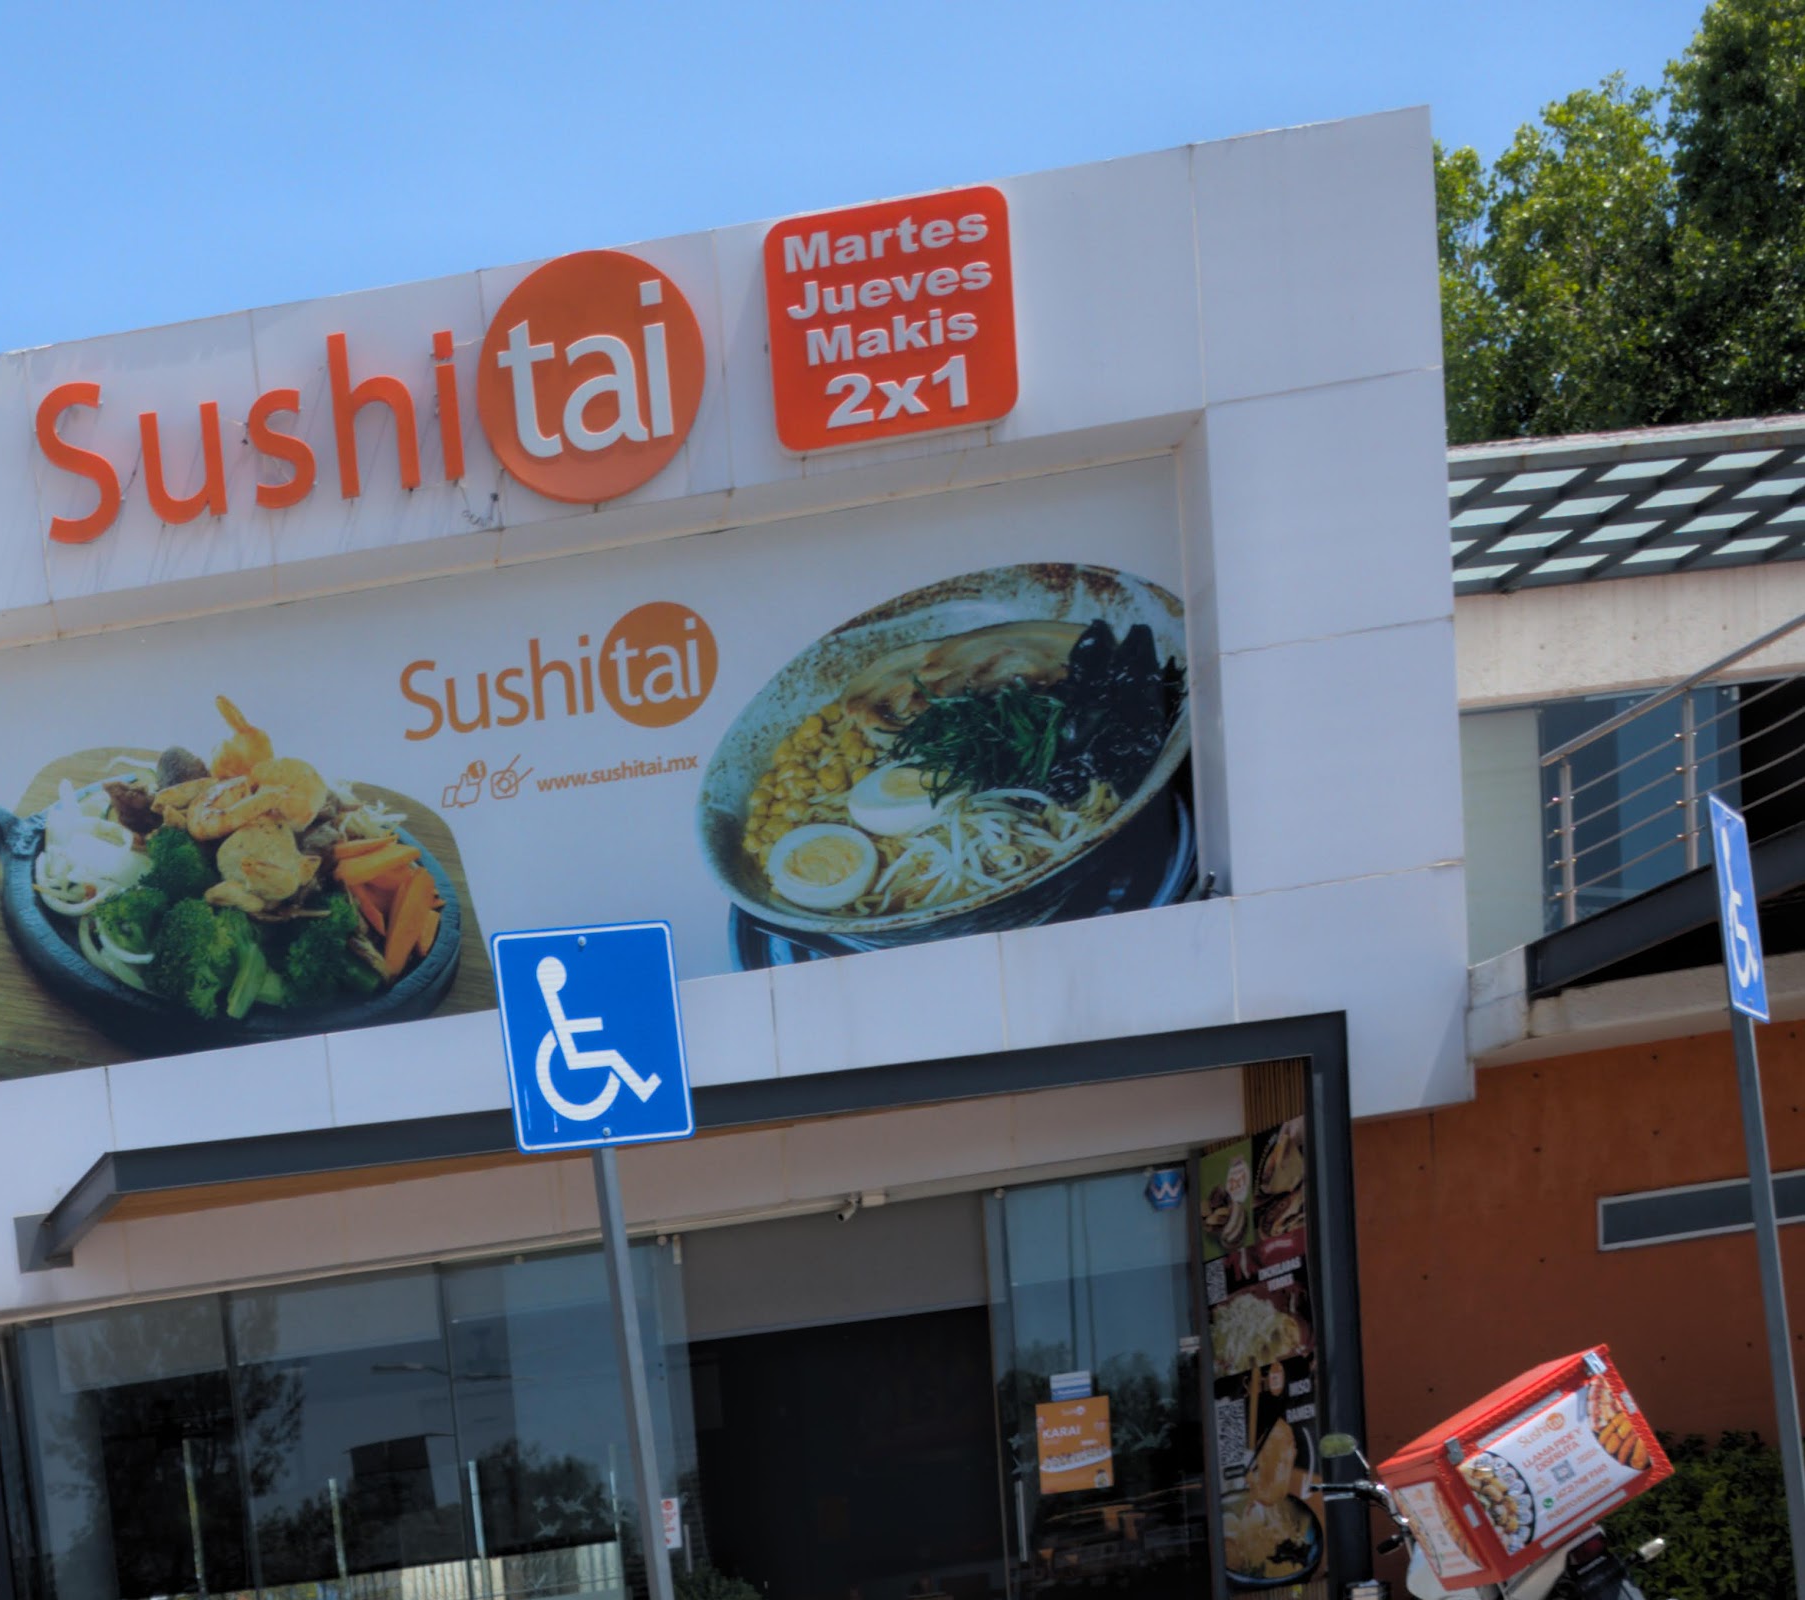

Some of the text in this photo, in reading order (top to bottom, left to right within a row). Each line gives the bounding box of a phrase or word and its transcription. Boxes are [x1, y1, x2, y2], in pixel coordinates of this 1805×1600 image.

[783, 213, 988, 273] Martes
[786, 261, 992, 319] Jueves
[806, 308, 978, 366] Makis
[825, 354, 969, 429] 2x1
[537, 755, 699, 793] www.sushitai.mx
